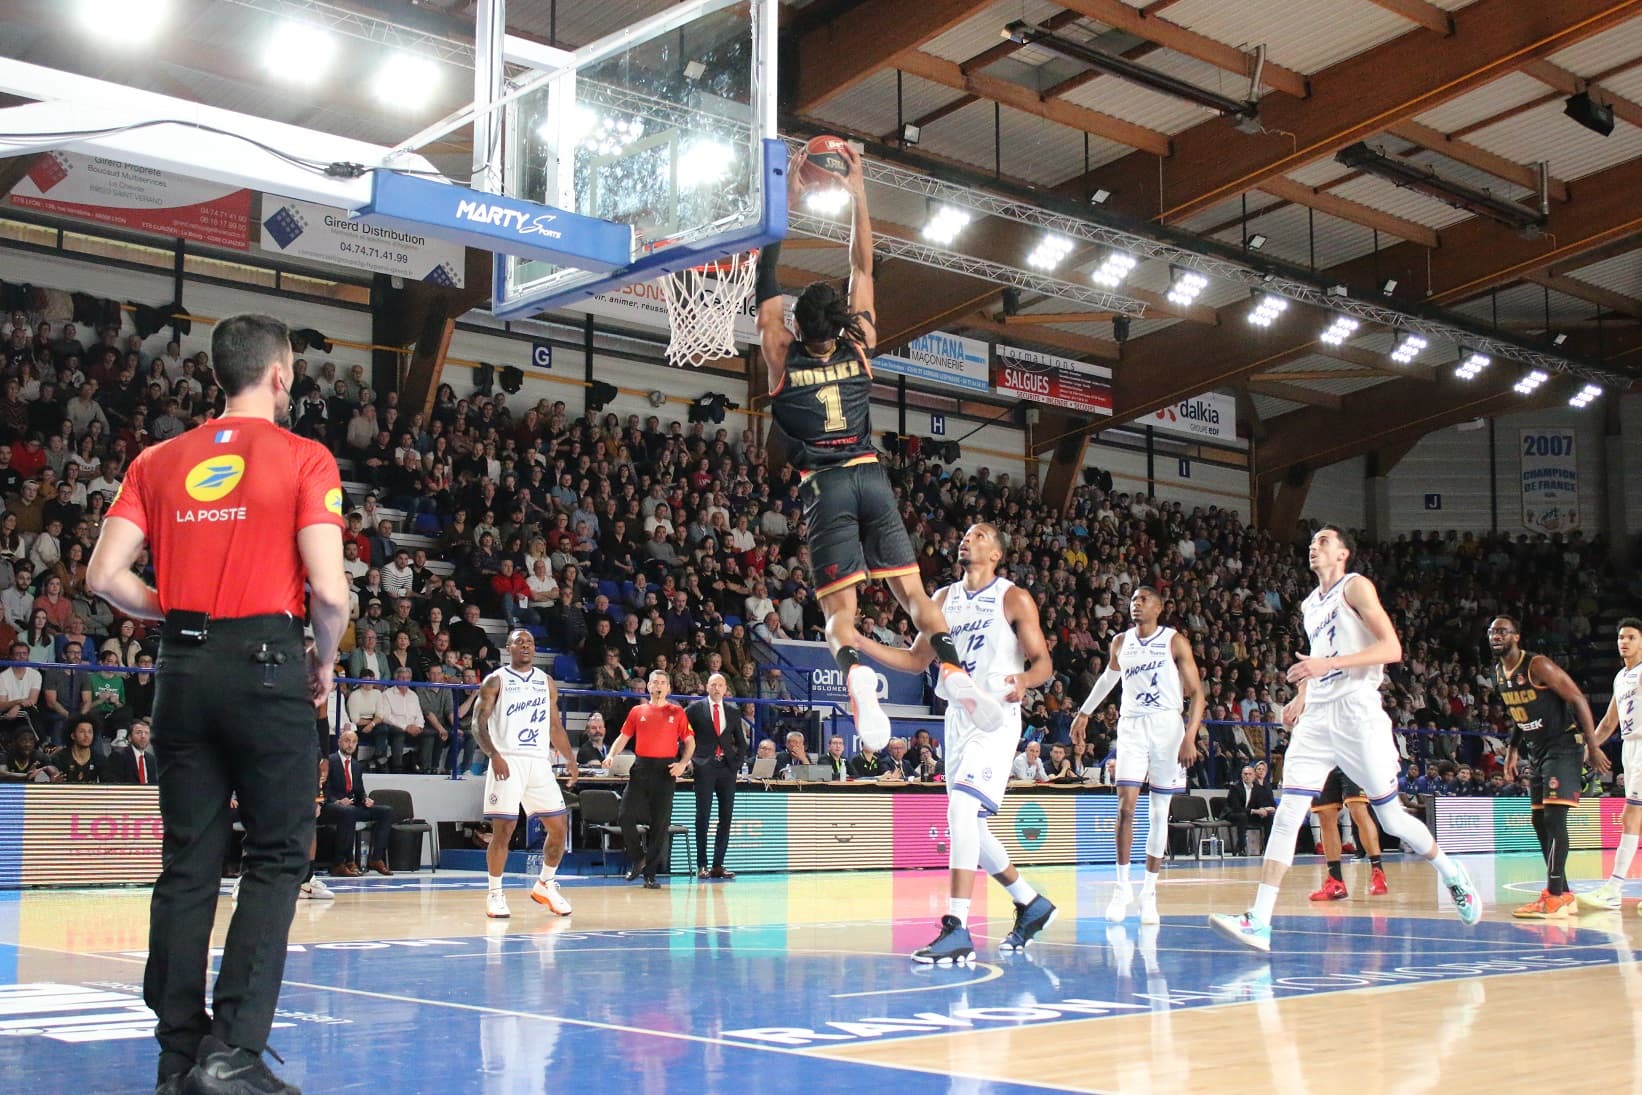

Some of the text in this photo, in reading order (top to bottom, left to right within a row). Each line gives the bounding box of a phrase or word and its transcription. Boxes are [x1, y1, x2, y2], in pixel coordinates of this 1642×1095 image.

[456, 199, 531, 230] MARTY
[324, 215, 359, 233] Girerd
[362, 223, 426, 246] Distribution
[608, 296, 640, 310] animer,
[534, 346, 550, 366] G
[911, 334, 965, 362] MATTANA
[911, 350, 965, 372] MAÇONNERIE
[1004, 368, 1050, 394] SALGUES
[816, 384, 847, 432] 1
[1180, 400, 1219, 425] dalkia
[933, 417, 943, 433] H
[1523, 435, 1573, 457] 2007
[1523, 467, 1577, 481] CHAMPION
[1524, 481, 1577, 493] DE FRANCE
[1428, 495, 1438, 508] J
[176, 507, 247, 523] LA POSTE
[966, 633, 985, 653] 12
[719, 998, 1151, 1044] RAVON
